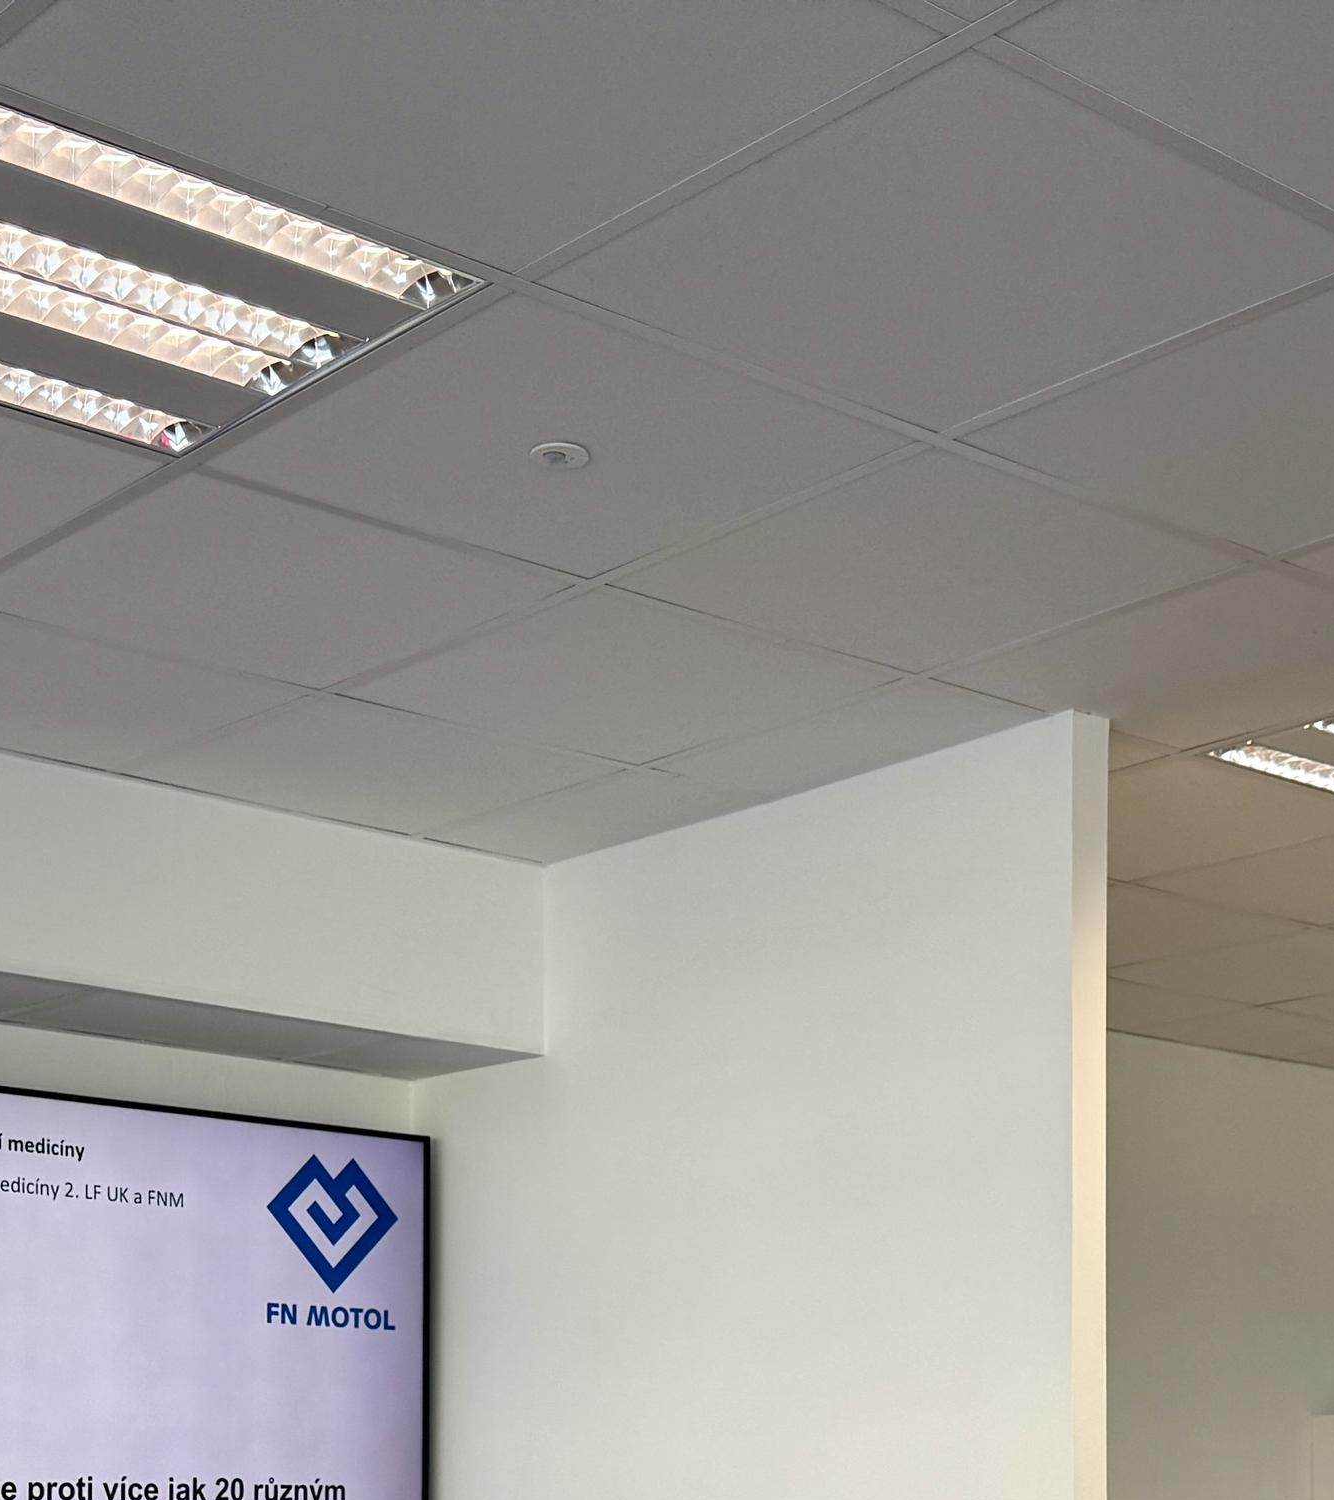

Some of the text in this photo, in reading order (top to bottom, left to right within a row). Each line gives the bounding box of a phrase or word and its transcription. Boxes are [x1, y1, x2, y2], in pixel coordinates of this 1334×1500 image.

[9, 1138, 84, 1162] medicíny
[65, 1183, 78, 1198] 2.
[86, 1184, 101, 1199] LF
[108, 1187, 128, 1203] UK
[134, 1193, 141, 1204] a
[149, 1190, 183, 1207] FNM
[267, 1303, 395, 1330] FN MOTOL
[103, 1476, 158, 1500] více
